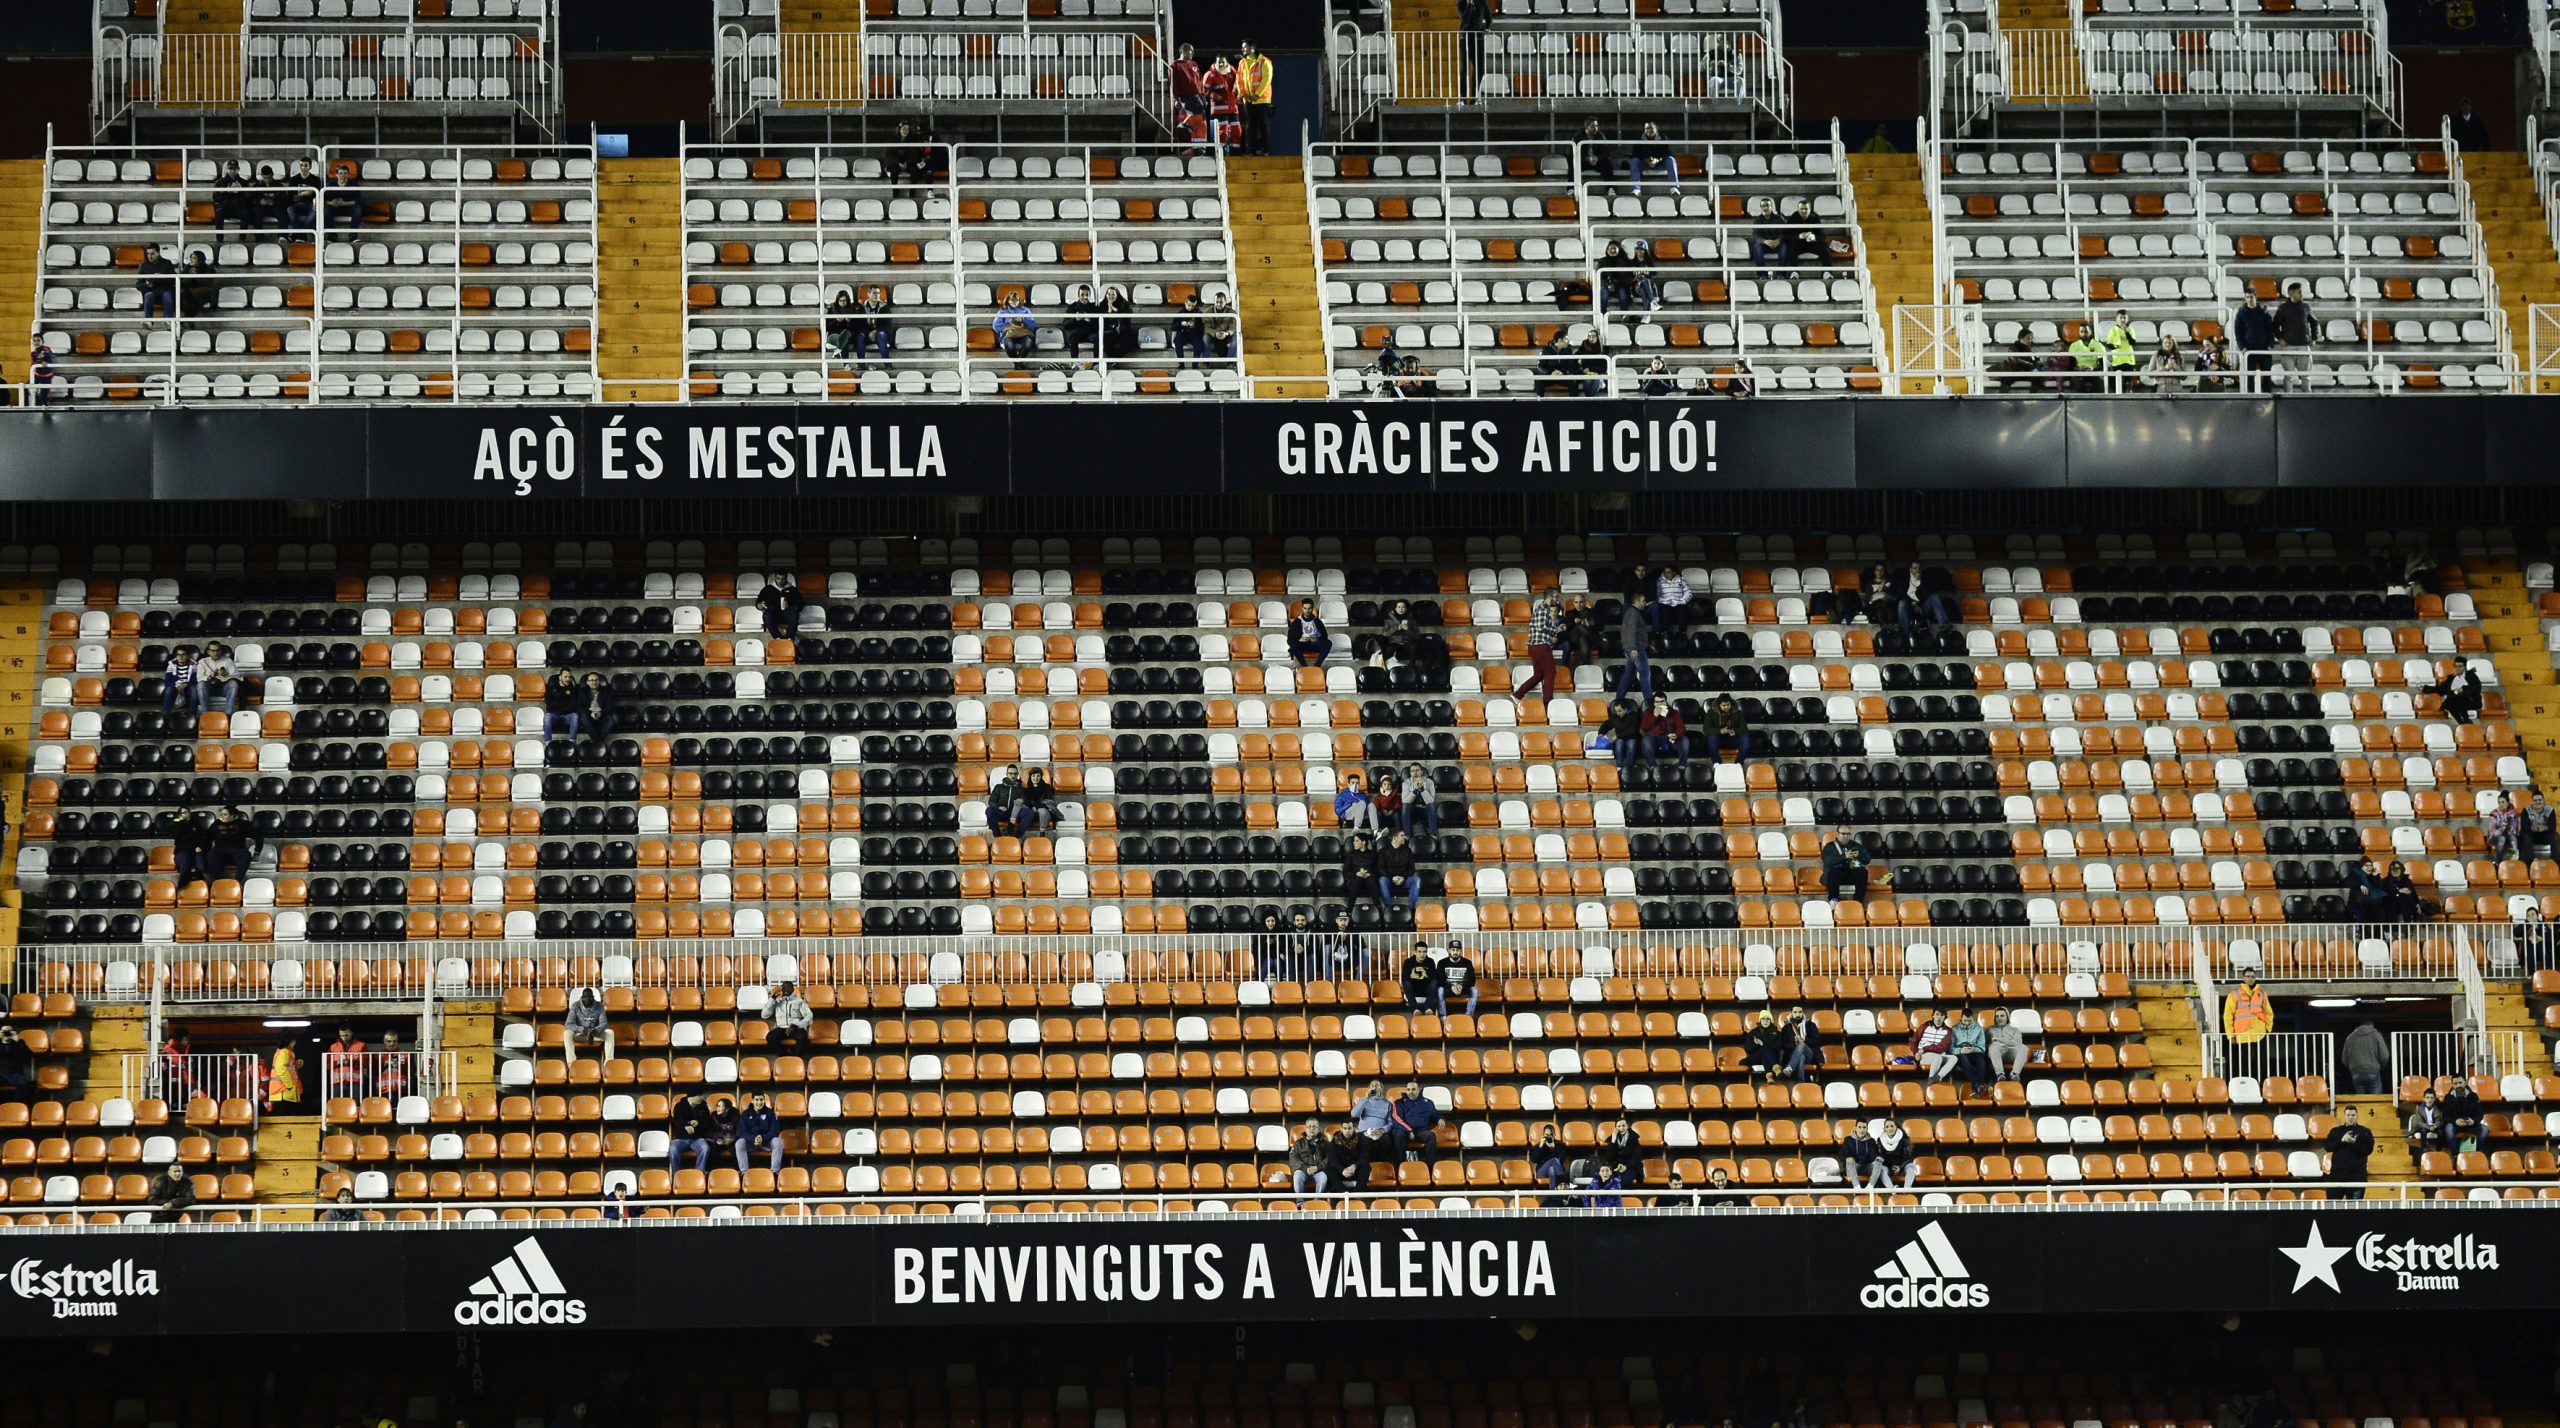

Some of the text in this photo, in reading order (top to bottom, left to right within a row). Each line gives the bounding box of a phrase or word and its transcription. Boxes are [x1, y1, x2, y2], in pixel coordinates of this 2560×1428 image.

[473, 414, 947, 496] AÇÒ ÉS MESTALLA
[1278, 407, 1717, 475] GRÀCIES AFICIÓ!
[894, 1227, 1556, 1304] BENVINGUTS A VALÈNCIA
[2355, 1230, 2500, 1272] Estrella
[10, 1256, 160, 1299] Estrella
[1859, 1276, 1990, 1309] adidas
[2396, 1271, 2460, 1292] Damm
[51, 1297, 118, 1319] Damm
[454, 1292, 587, 1326] adidas
